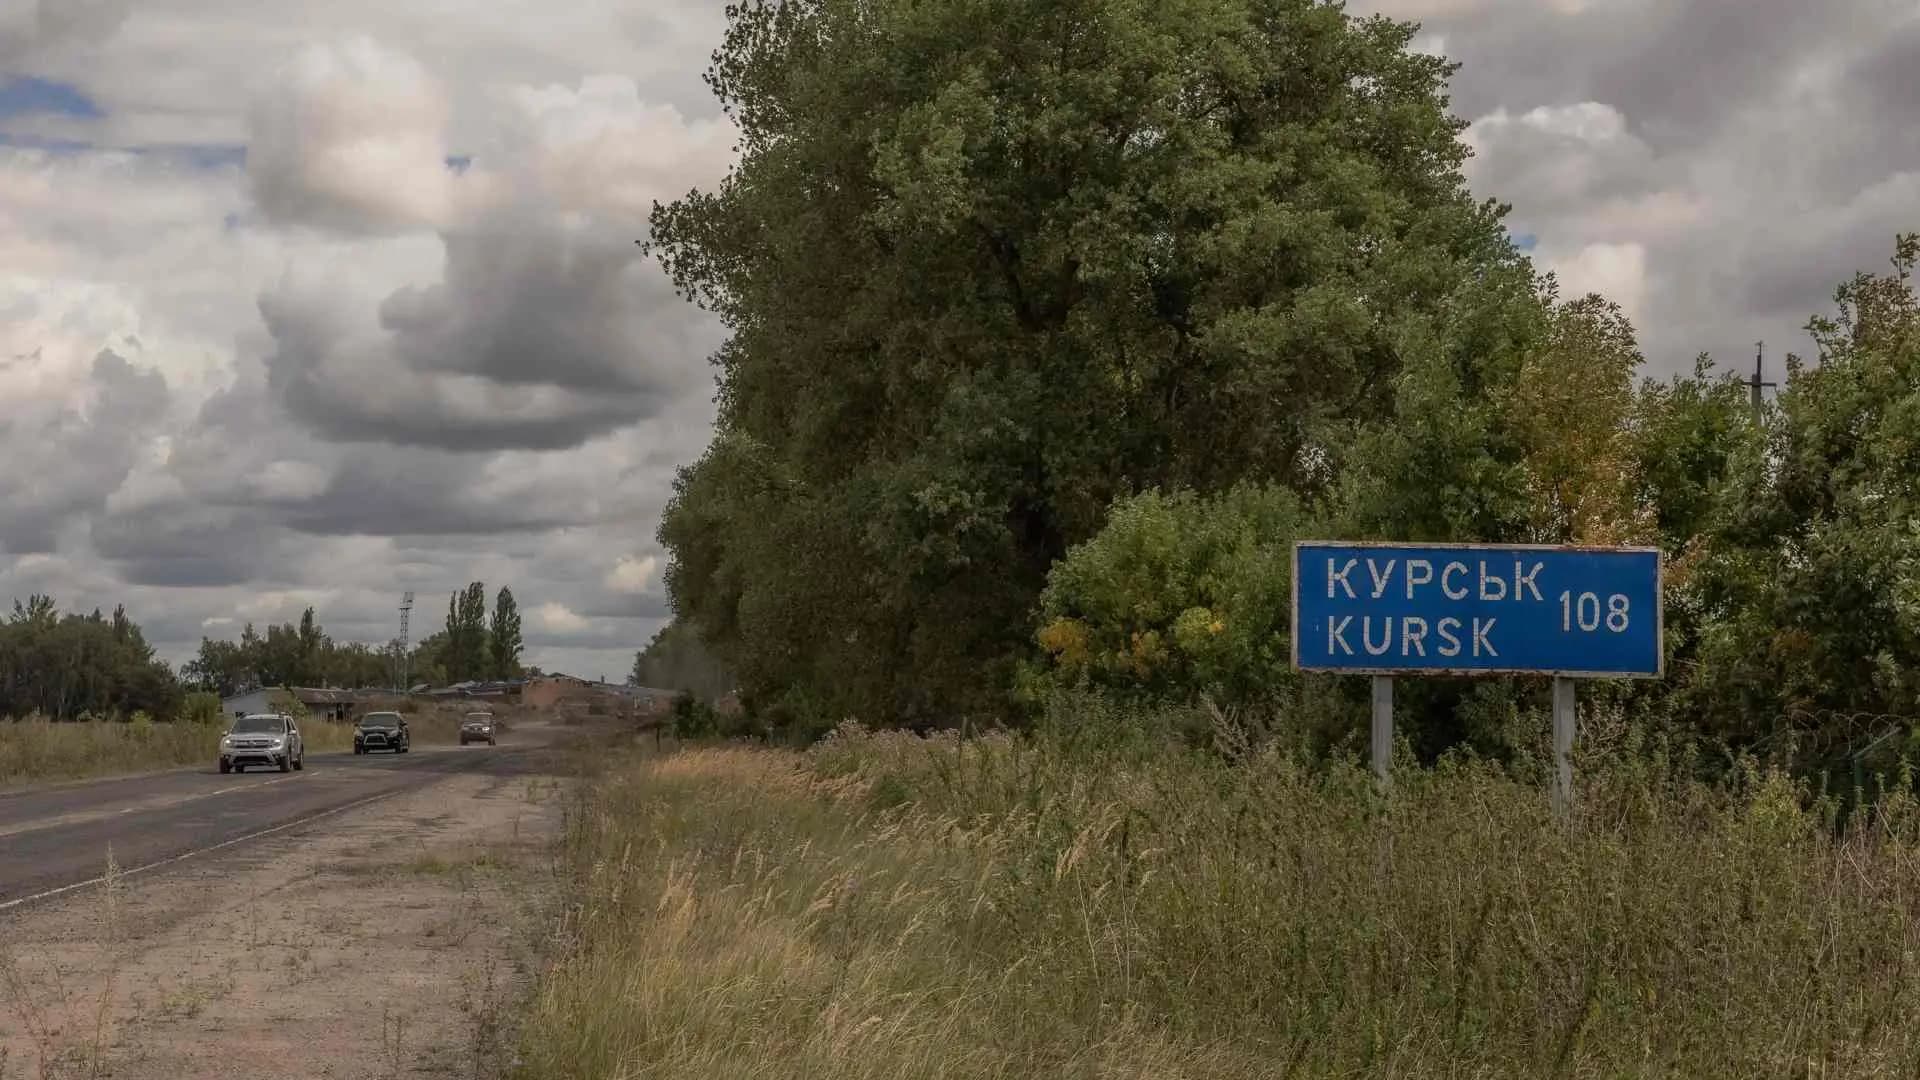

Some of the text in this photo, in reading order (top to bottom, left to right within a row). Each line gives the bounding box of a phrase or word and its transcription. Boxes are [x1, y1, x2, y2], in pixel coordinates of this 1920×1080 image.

[1327, 558, 1544, 601] КУРСЬК
[1559, 590, 1630, 633] 108
[1328, 615, 1498, 657] KURSK
